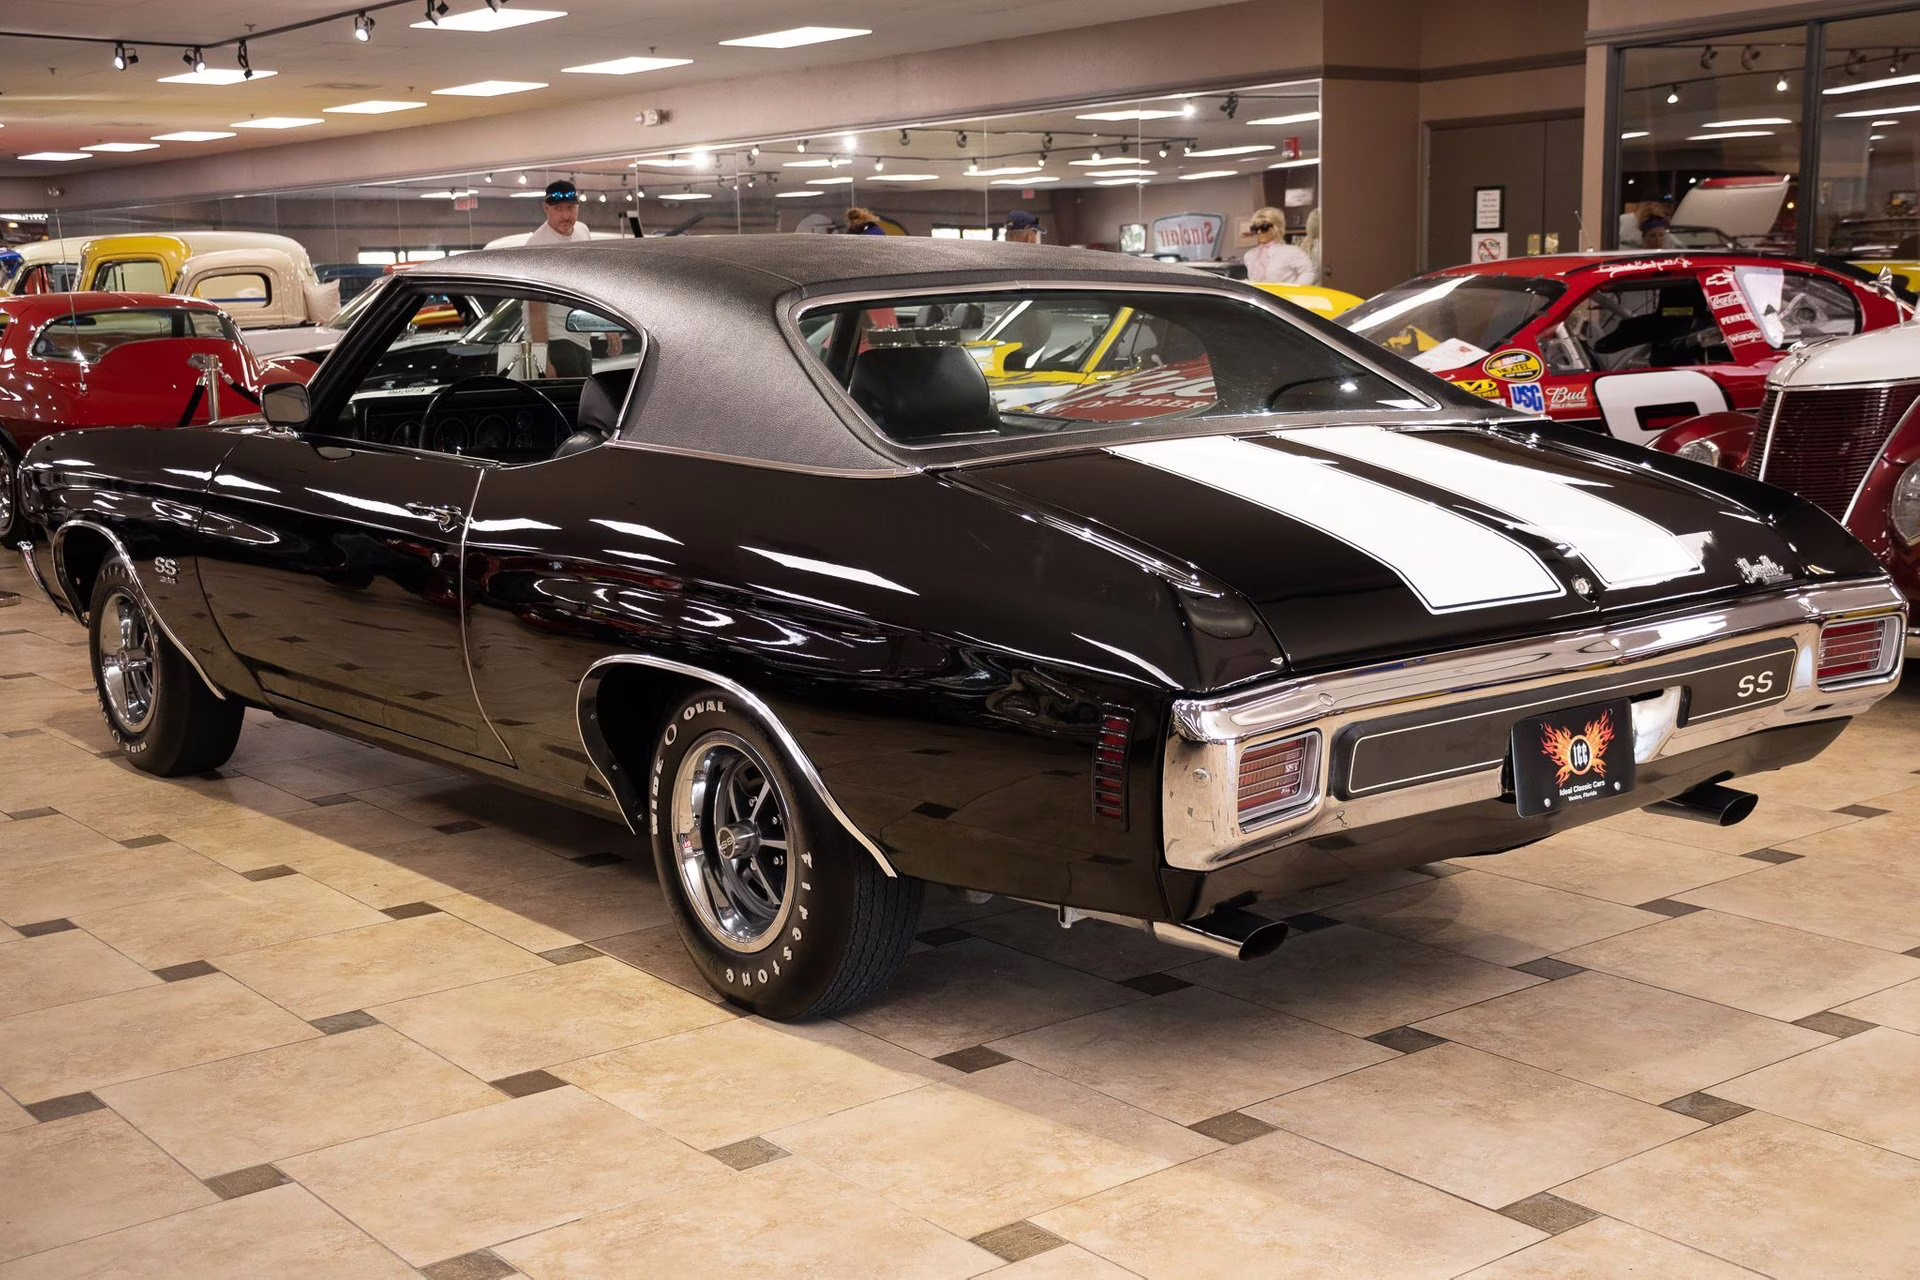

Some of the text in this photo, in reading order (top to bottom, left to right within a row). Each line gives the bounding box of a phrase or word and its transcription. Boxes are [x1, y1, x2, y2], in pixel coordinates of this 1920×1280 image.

[1511, 385, 1543, 411] USG
[1545, 386, 1588, 403] Bud
[154, 556, 177, 575] SS
[1736, 670, 1774, 698] SS
[683, 700, 726, 720] OVAL
[651, 755, 664, 835] WIDE
[1559, 780, 1606, 797] Ideal Classic Cars
[720, 836, 734, 850] SS
[725, 851, 813, 987] Firestone
